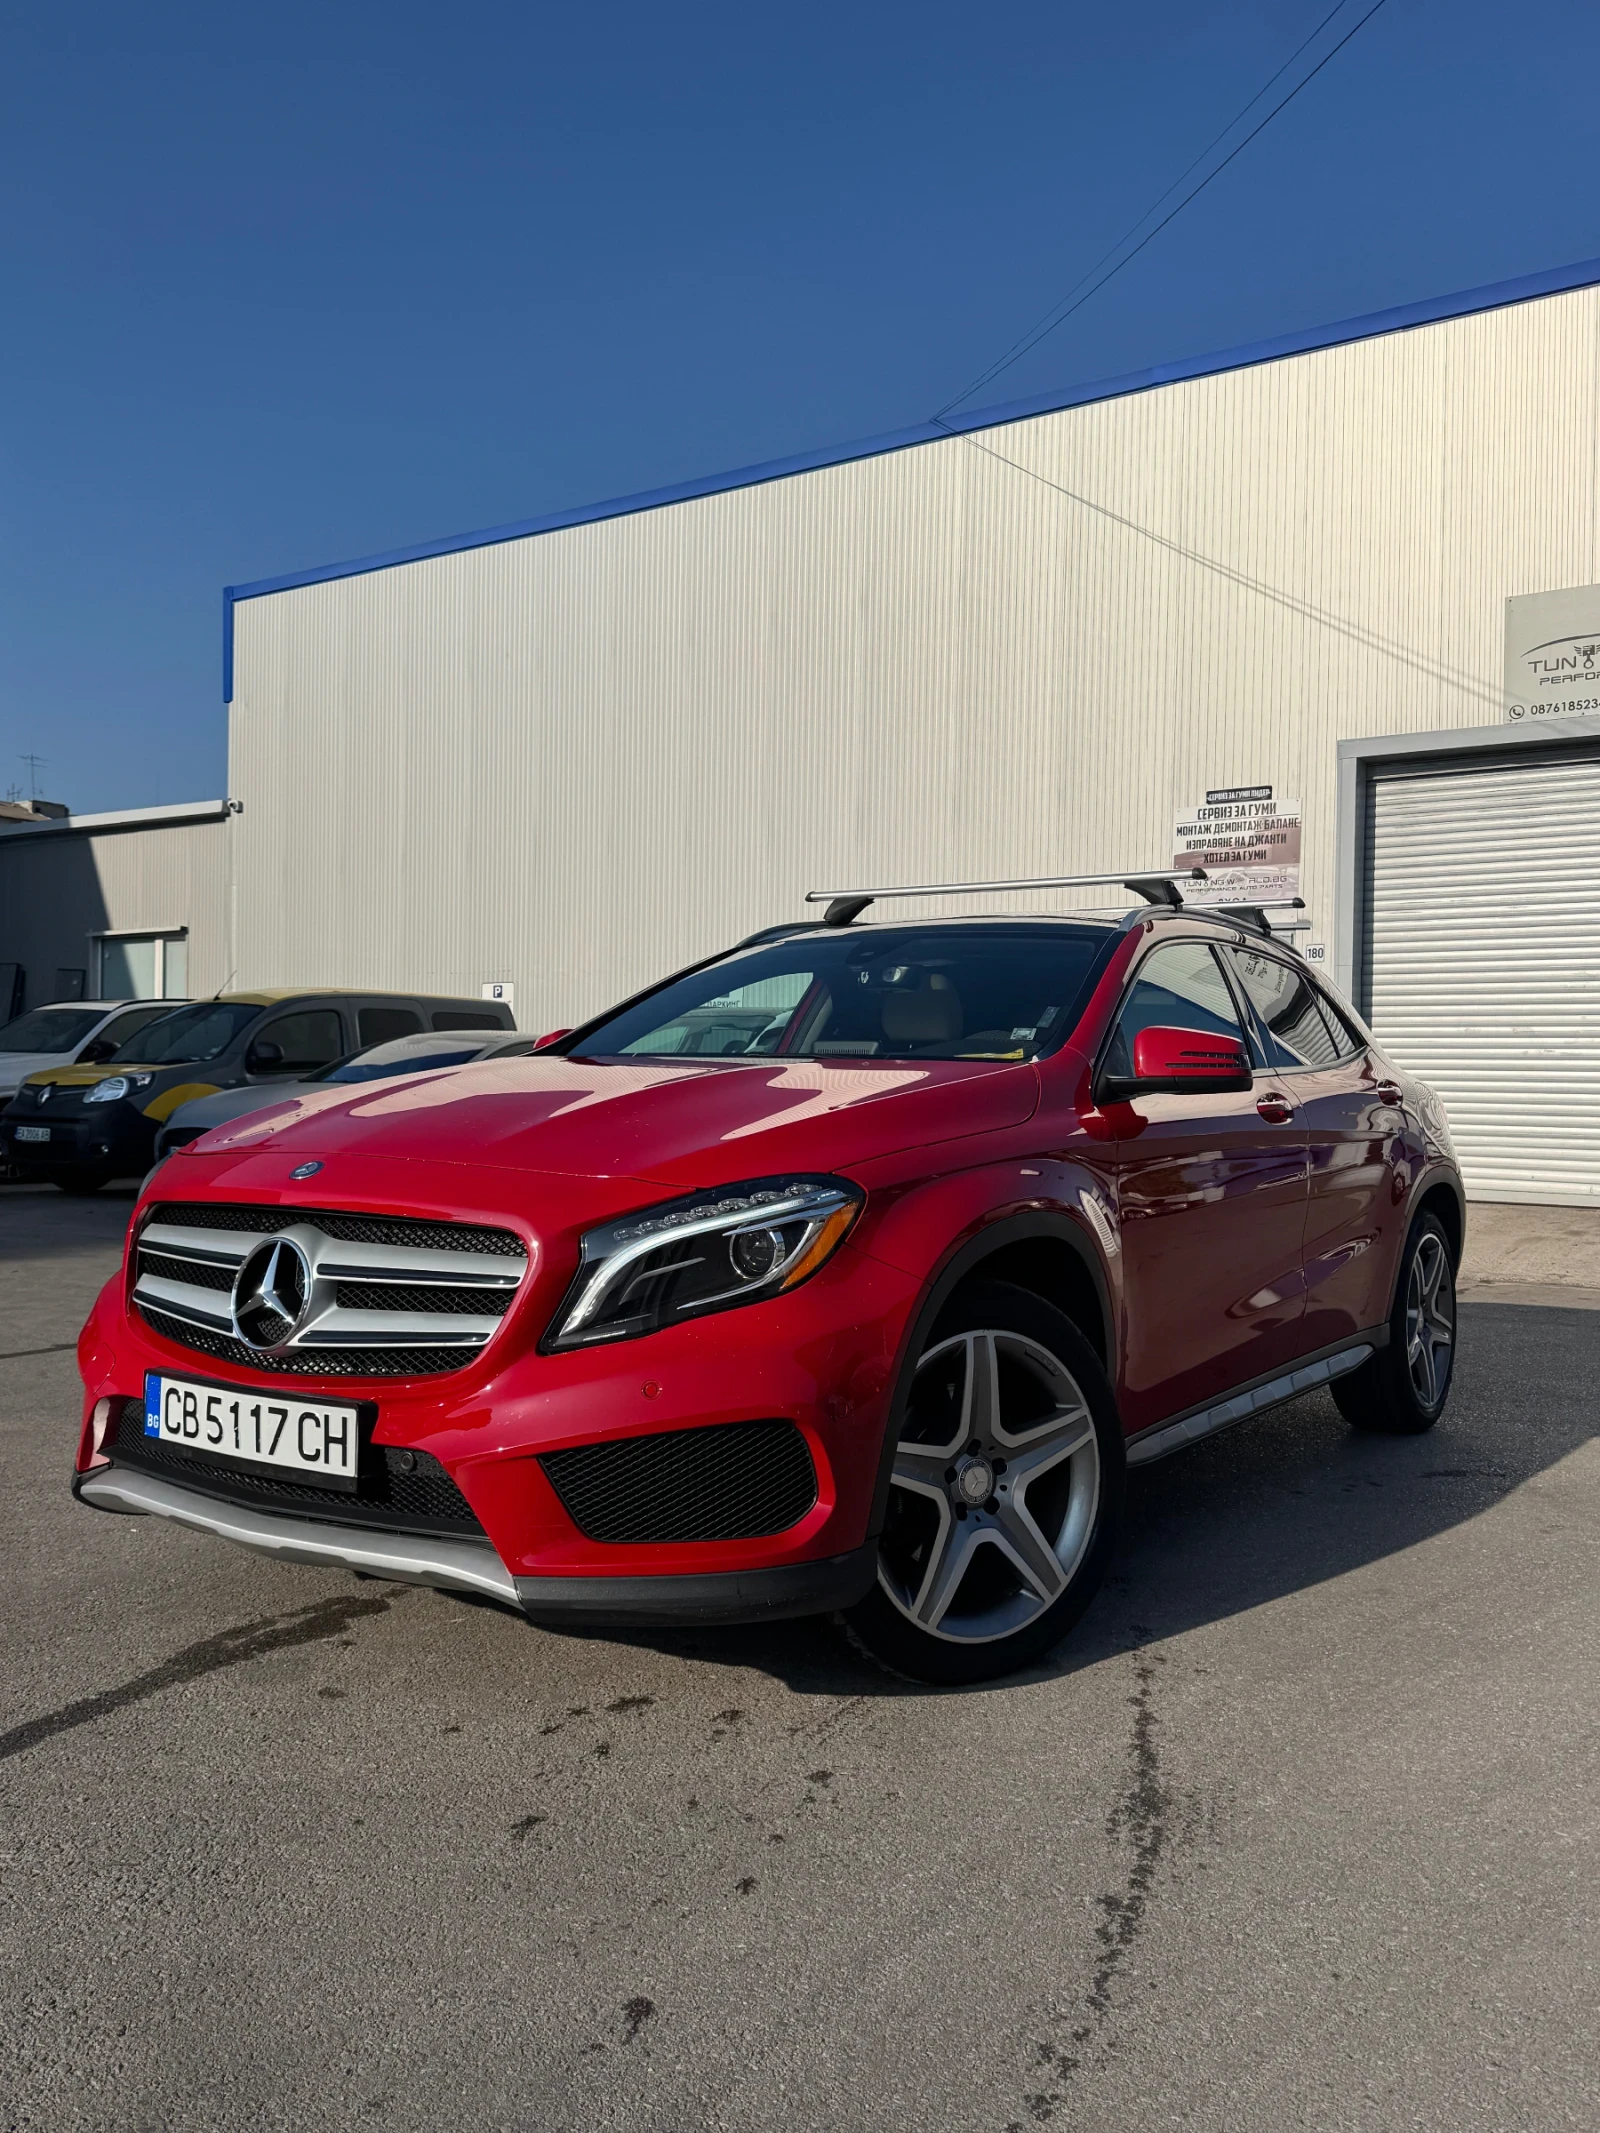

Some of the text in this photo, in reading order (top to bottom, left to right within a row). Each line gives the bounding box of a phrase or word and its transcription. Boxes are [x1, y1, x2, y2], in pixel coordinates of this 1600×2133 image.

[1530, 698, 1600, 715] 087618523
[1197, 802, 1277, 820] СЕРВИЗ ЗА ГУМИ
[1176, 823, 1212, 837] МОНТАЖ
[1213, 820, 1262, 835] ДЕМОНТАЖ
[1186, 833, 1287, 850] ИЗПРАВЯНЕ НА ДЖАНТИ
[1203, 849, 1267, 864] ХОТЕЛ ЗА ГУМИ
[1307, 947, 1324, 959] 180
[147, 1413, 159, 1429] BG
